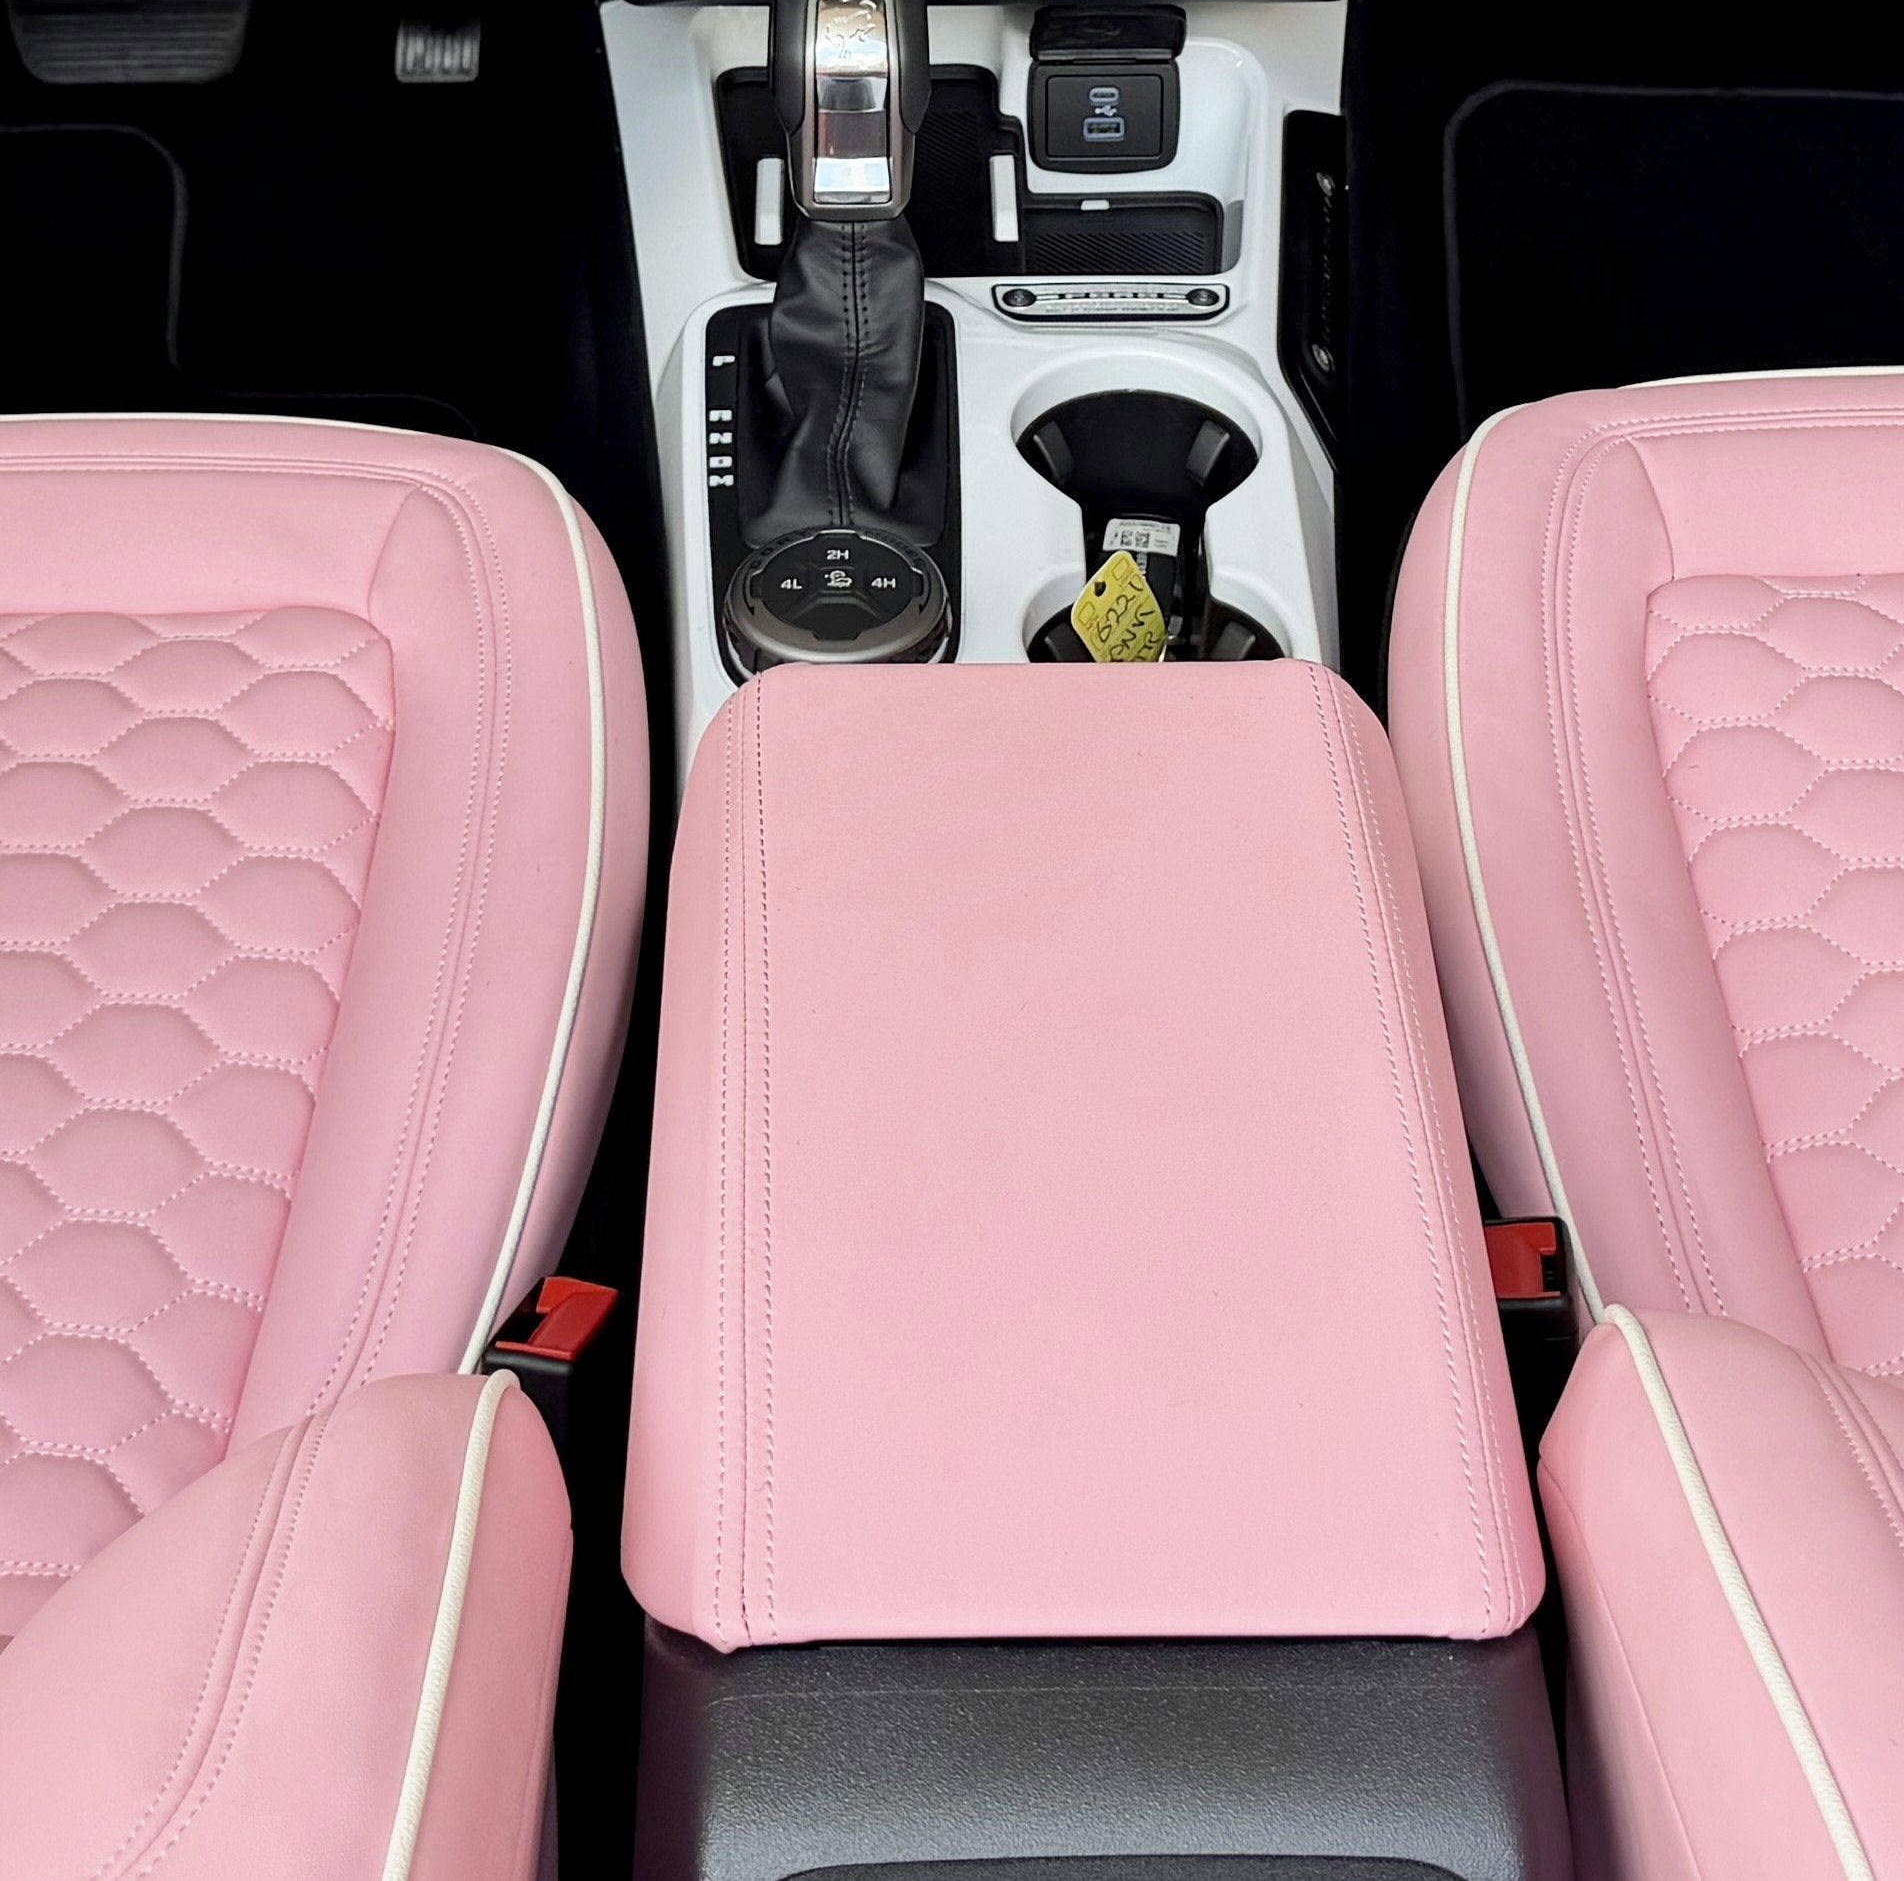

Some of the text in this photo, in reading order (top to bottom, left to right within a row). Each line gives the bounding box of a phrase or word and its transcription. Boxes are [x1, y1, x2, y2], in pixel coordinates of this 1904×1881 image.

[712, 355, 736, 367] P
[709, 432, 733, 444] N
[709, 456, 733, 468] D
[709, 474, 734, 487] M
[826, 548, 850, 561] 2H
[780, 577, 896, 591] 4L 4H
